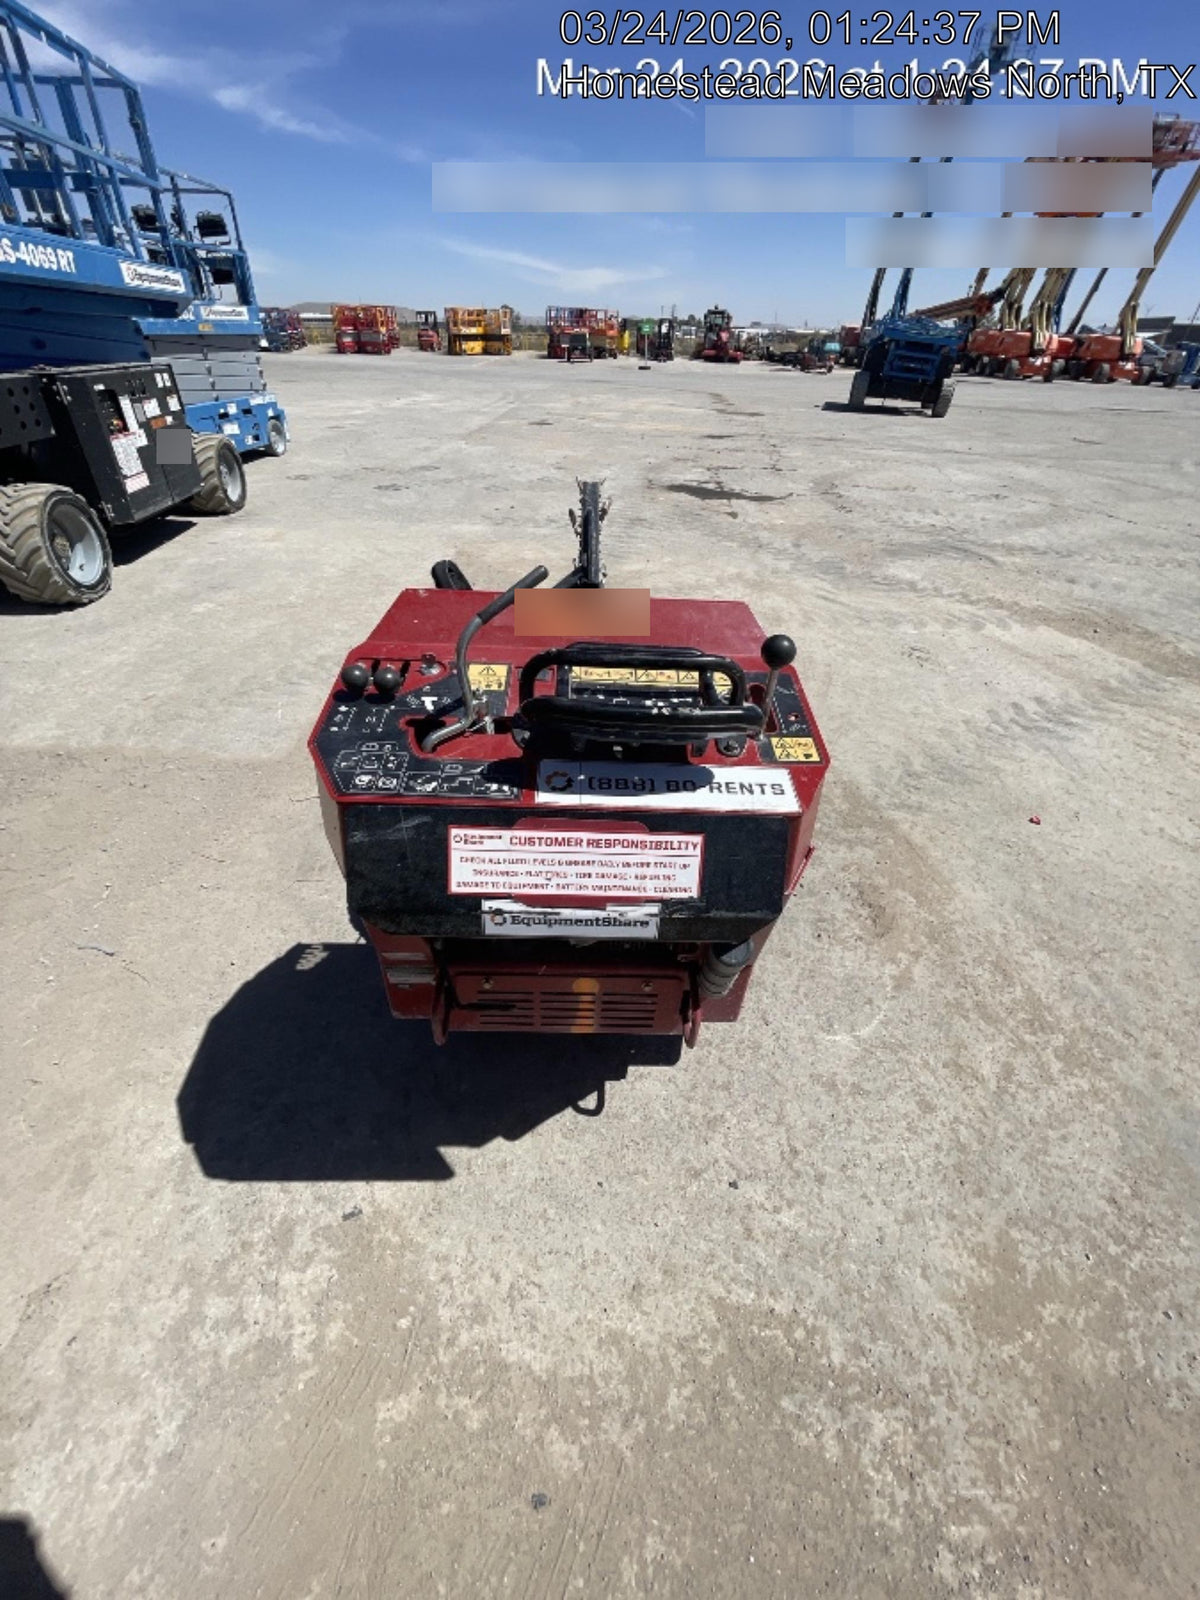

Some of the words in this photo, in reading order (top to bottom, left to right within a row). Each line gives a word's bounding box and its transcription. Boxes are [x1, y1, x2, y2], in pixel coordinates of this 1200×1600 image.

[0, 238, 58, 271] S-4069
[56, 248, 76, 274] RT
[588, 777, 656, 792] (888)
[510, 835, 584, 848] CUSTOMER
[586, 838, 699, 851] RESPONSIBILITY
[510, 914, 650, 929] EquipmentShare
